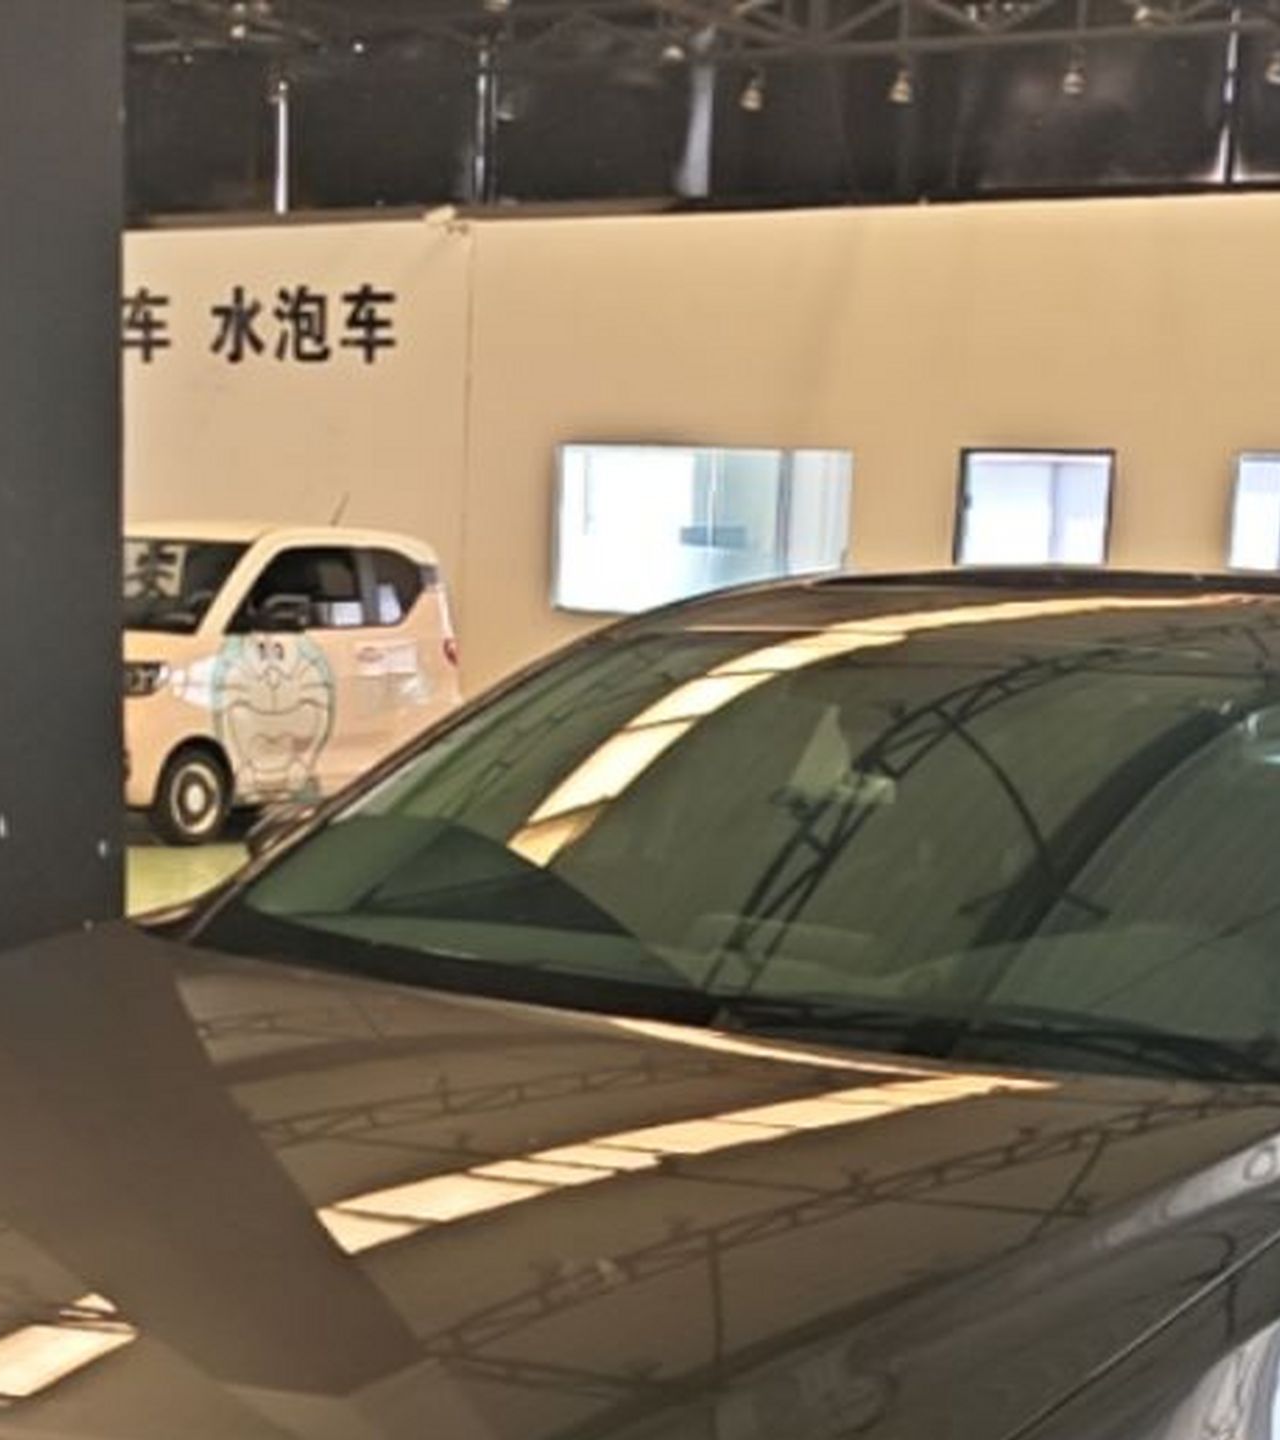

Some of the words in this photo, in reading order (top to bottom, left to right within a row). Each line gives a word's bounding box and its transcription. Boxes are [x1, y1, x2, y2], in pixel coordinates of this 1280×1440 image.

[122, 286, 170, 363] 车
[211, 283, 396, 363] 水泡车
